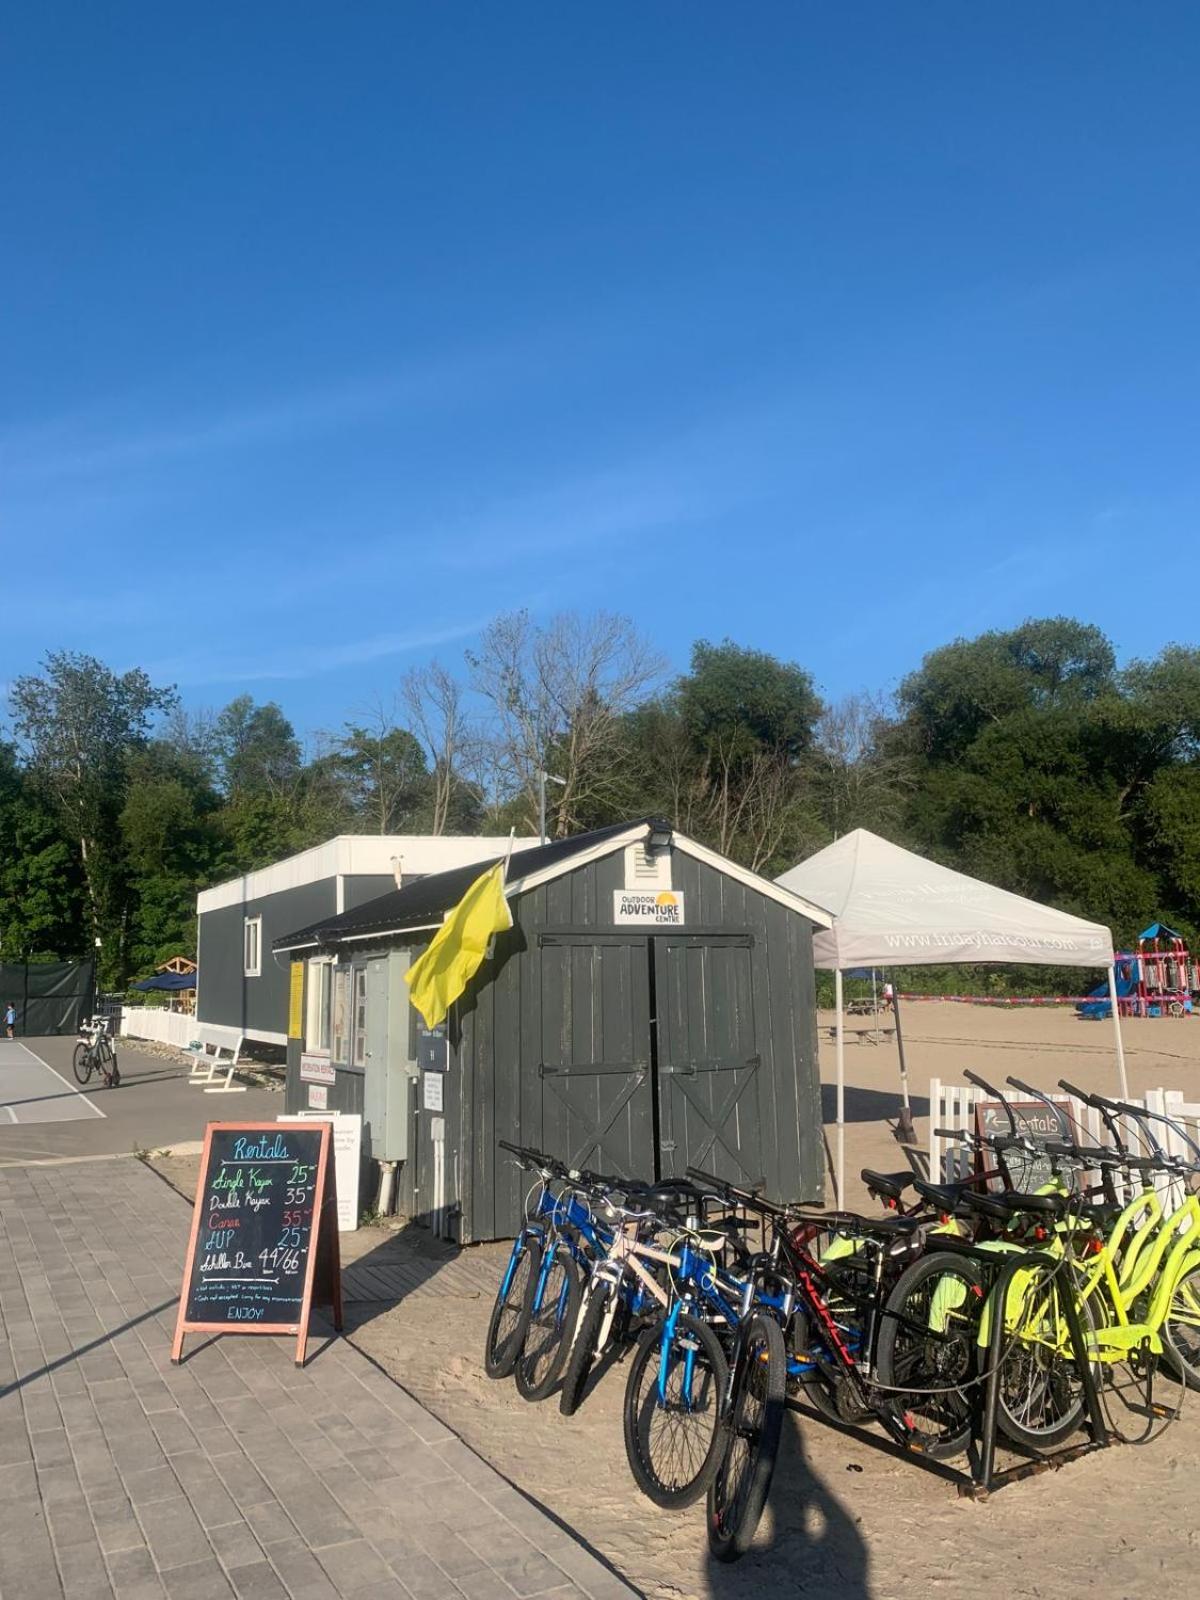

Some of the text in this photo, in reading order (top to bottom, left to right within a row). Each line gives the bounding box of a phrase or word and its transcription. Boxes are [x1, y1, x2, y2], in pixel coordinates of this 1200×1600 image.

[620, 904, 679, 916] ADVENTURE
[655, 915, 680, 923] CENTRE
[1016, 1114, 1058, 1132] entals
[233, 1134, 290, 1160] Rentals
[212, 1168, 244, 1194] Single
[210, 1190, 240, 1211] Double
[205, 1230, 235, 1250] SUP
